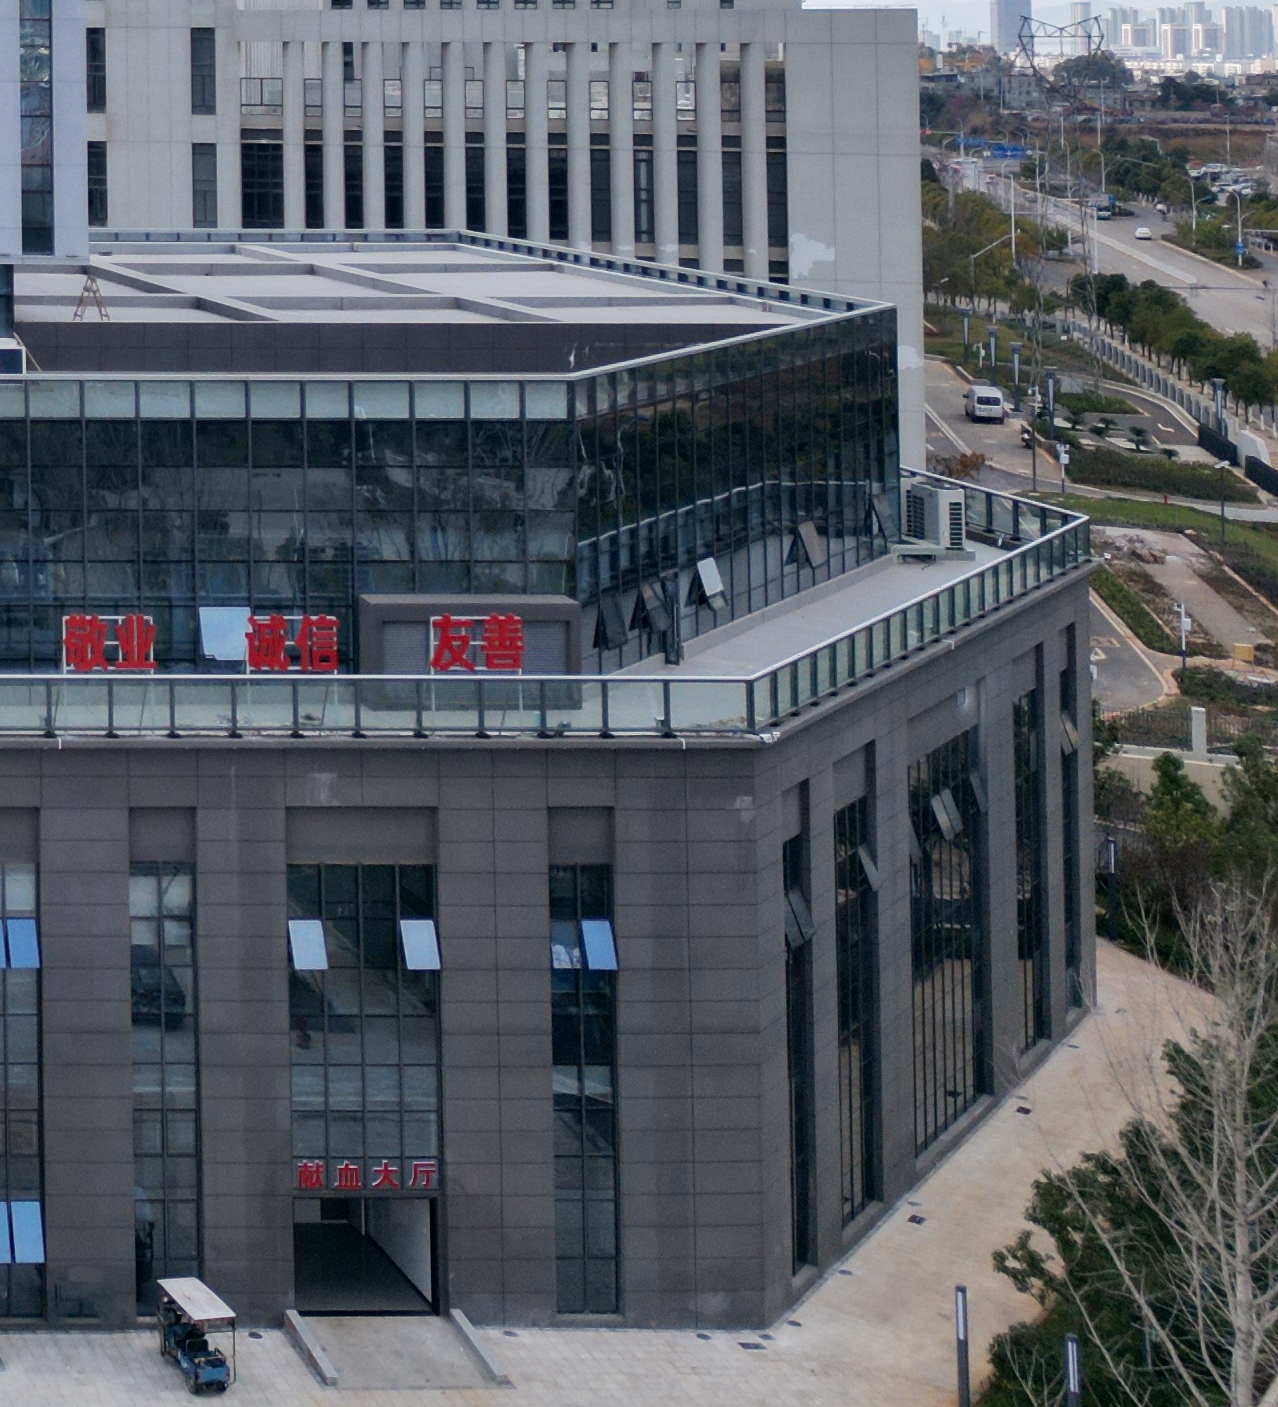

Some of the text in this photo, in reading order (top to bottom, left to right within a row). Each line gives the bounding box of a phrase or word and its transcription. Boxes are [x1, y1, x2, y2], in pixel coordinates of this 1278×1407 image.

[63, 614, 158, 672] 敬业
[245, 614, 340, 672] 诚信
[430, 613, 525, 671] 友善
[297, 1159, 437, 1190] 献血大厅
